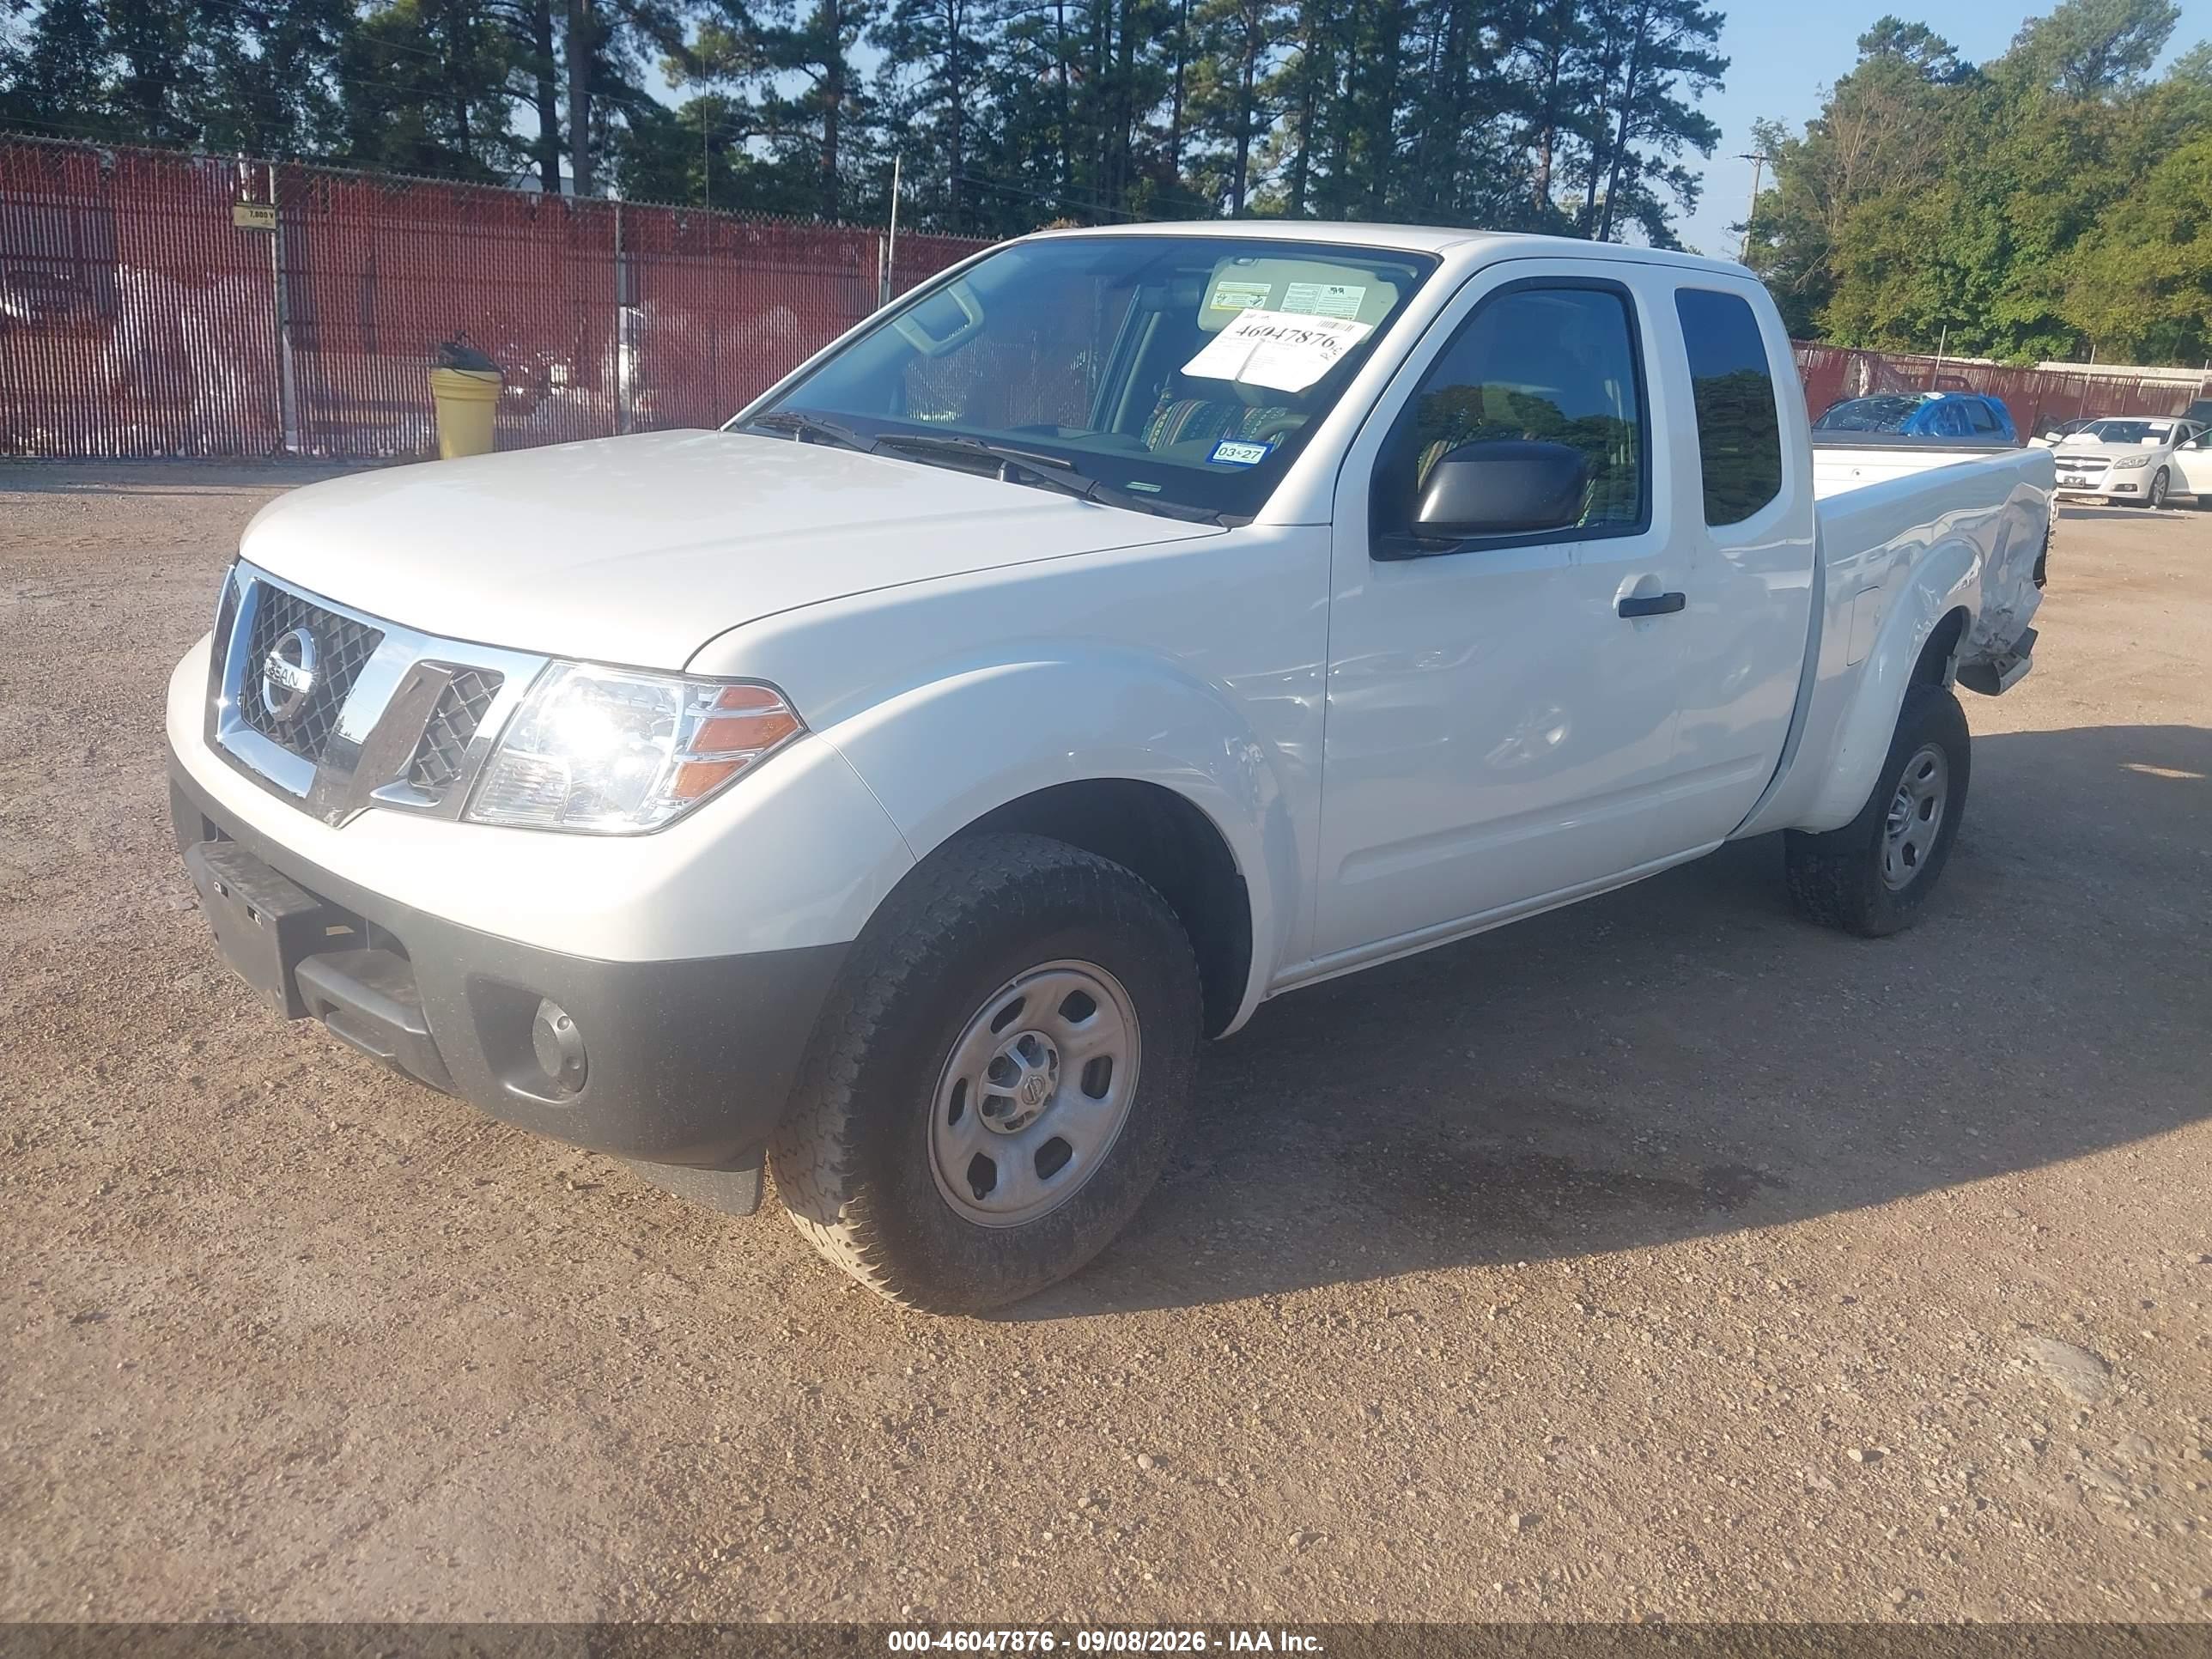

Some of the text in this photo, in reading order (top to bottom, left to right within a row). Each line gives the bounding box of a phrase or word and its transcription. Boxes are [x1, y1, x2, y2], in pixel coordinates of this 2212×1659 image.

[1236, 325, 1340, 348] 46047876
[1218, 447, 1261, 459] 03 27
